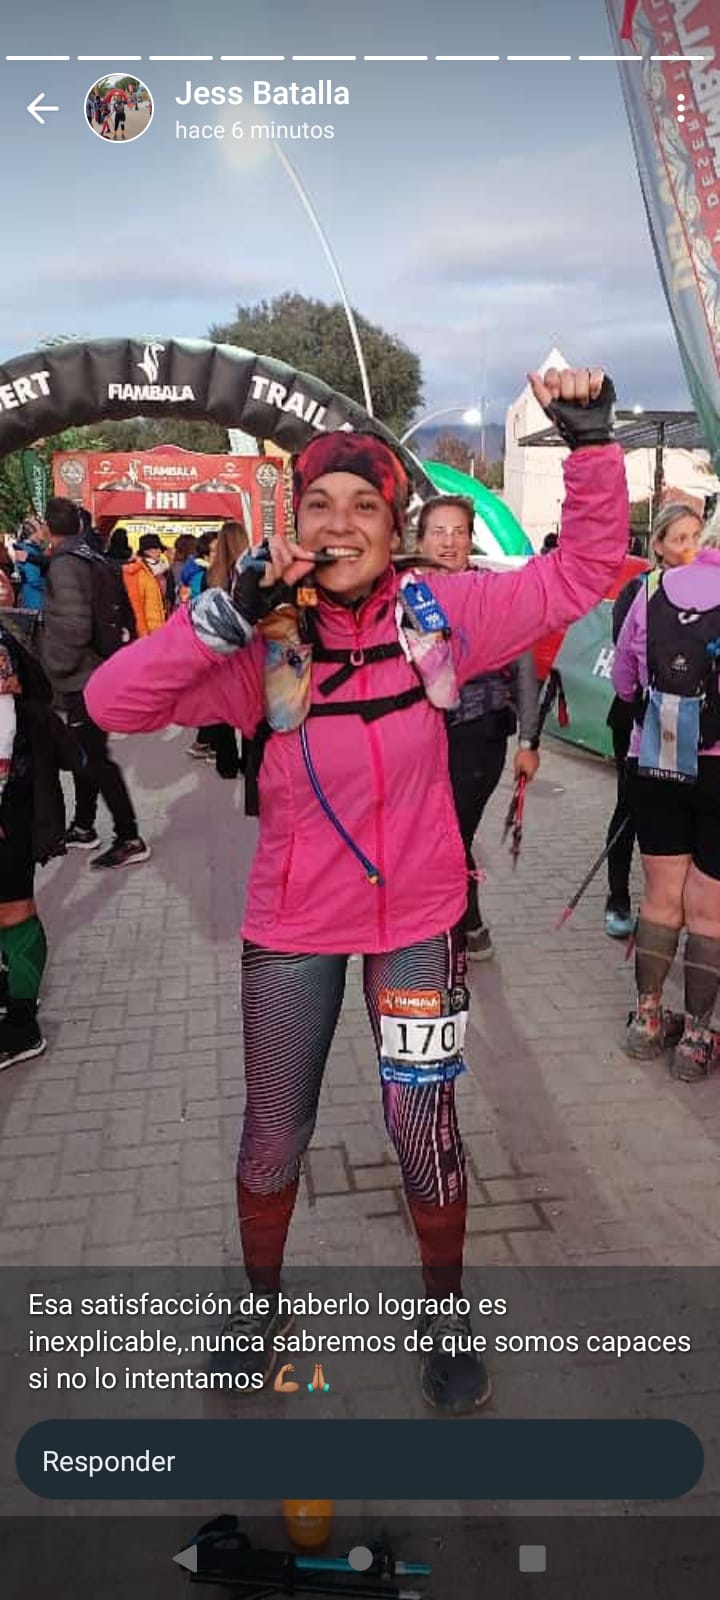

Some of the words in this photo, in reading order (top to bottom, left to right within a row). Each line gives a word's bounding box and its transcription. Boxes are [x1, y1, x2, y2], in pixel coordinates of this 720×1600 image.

[0, 370, 50, 412] ERT
[108, 383, 195, 402] FIAMBALA
[251, 375, 327, 431] TRAIL
[397, 1021, 455, 1055] 170
